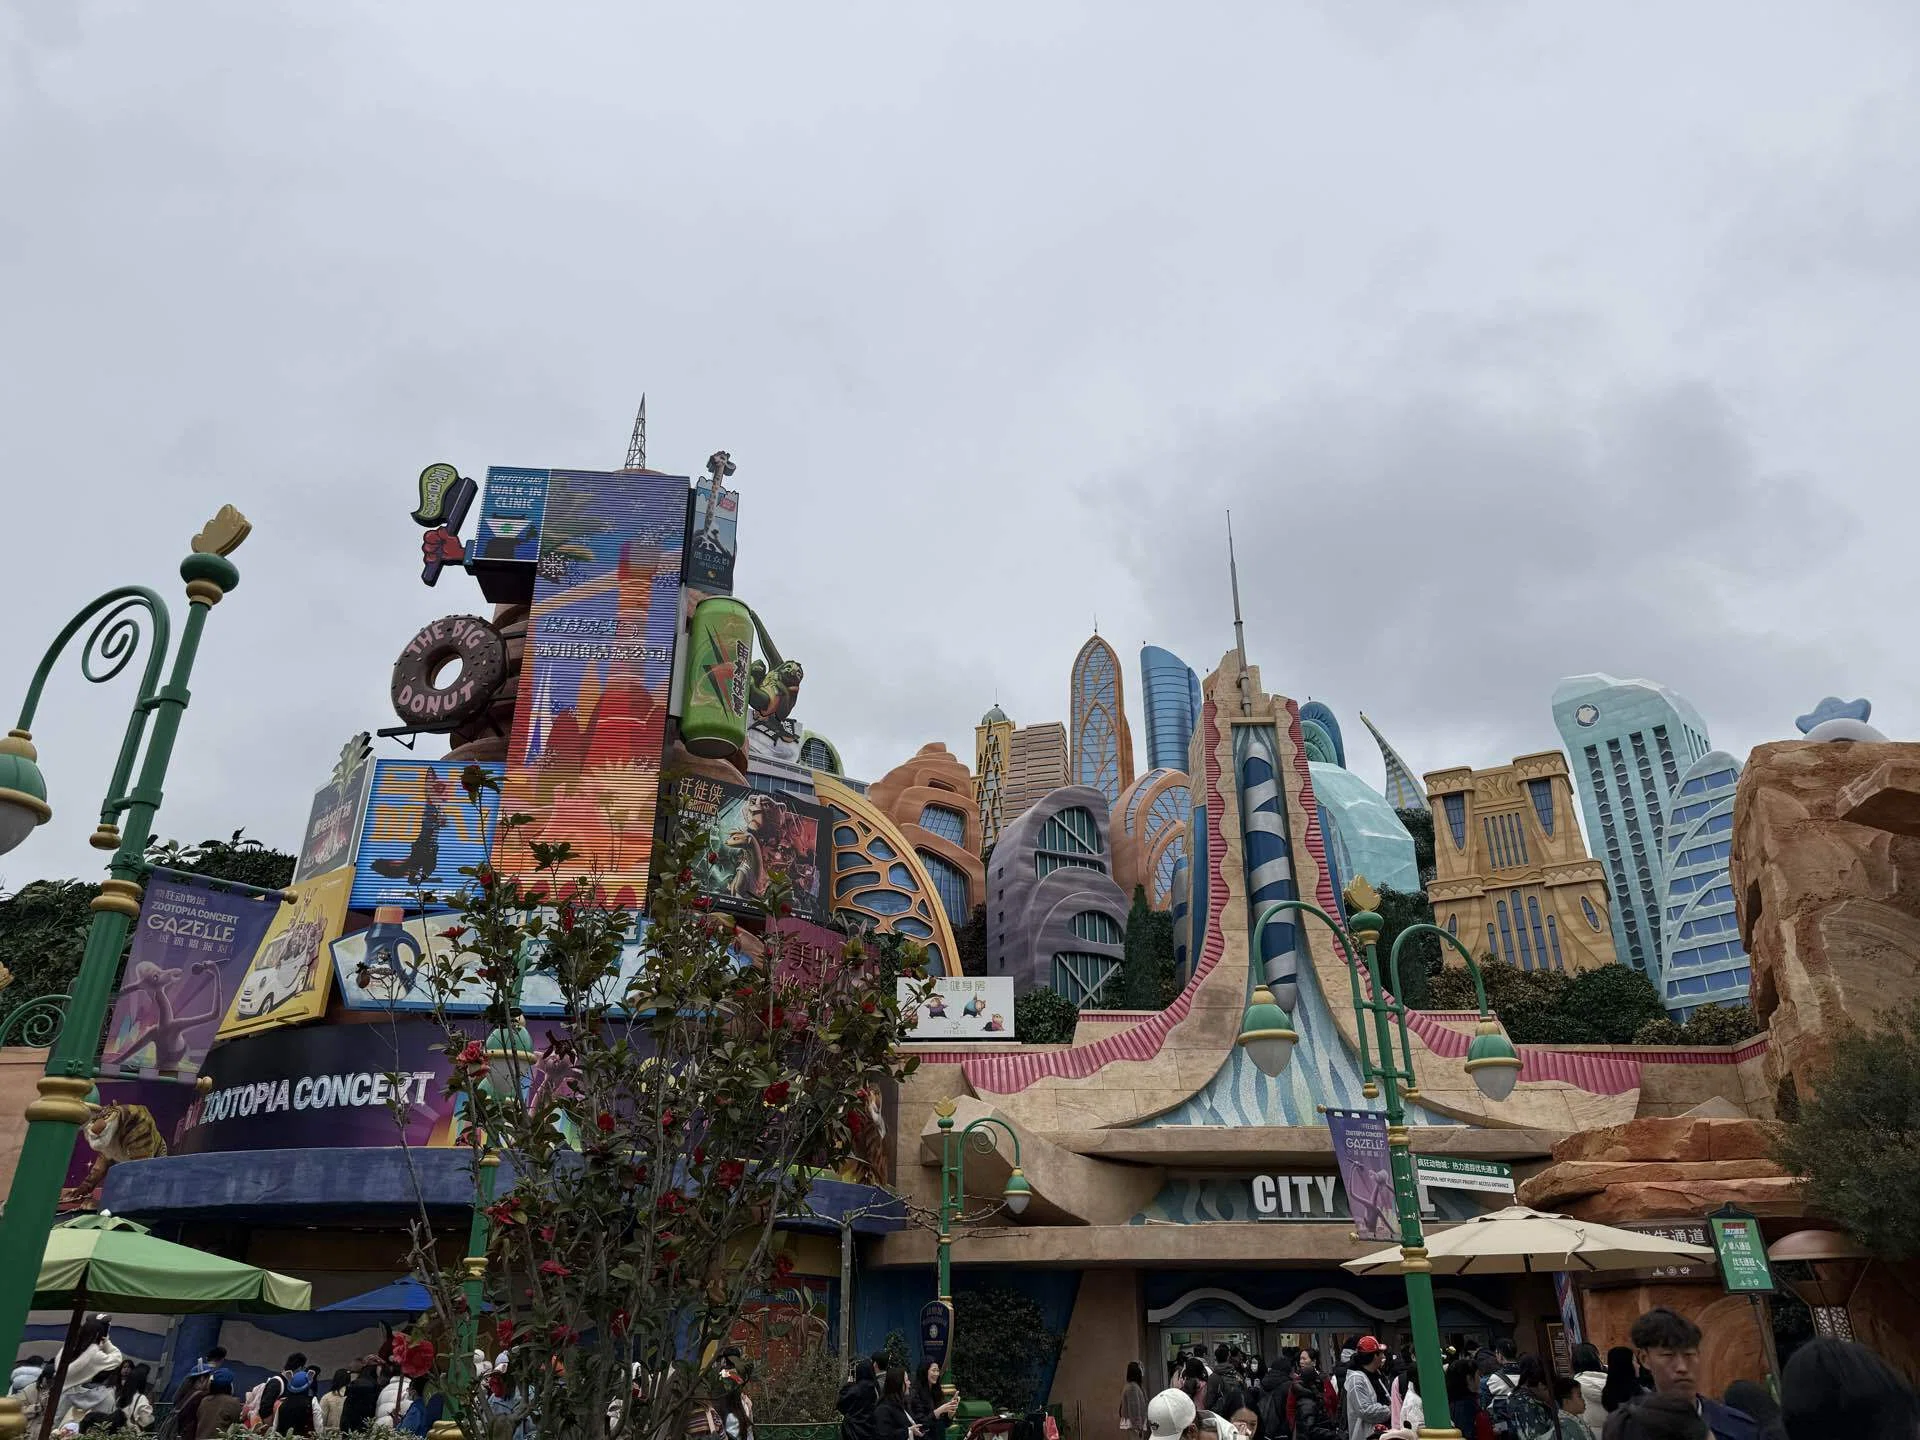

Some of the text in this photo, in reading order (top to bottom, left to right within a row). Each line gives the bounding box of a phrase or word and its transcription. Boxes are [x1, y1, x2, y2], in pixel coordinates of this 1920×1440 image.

[491, 485, 543, 497] WALK-IN
[494, 497, 536, 509] CLINIC
[406, 619, 487, 655] THE BIG
[397, 680, 475, 714] DONUT
[678, 776, 724, 805] 迁徙侠
[151, 901, 240, 925] ZOOTOPIA CONCERT
[147, 913, 236, 943] GAZELLE
[199, 1079, 290, 1126] ZOOTOPIA
[293, 1071, 436, 1111] CONCERT
[1345, 1137, 1386, 1150] GAZELLE
[1252, 1175, 1336, 1213] CITY
